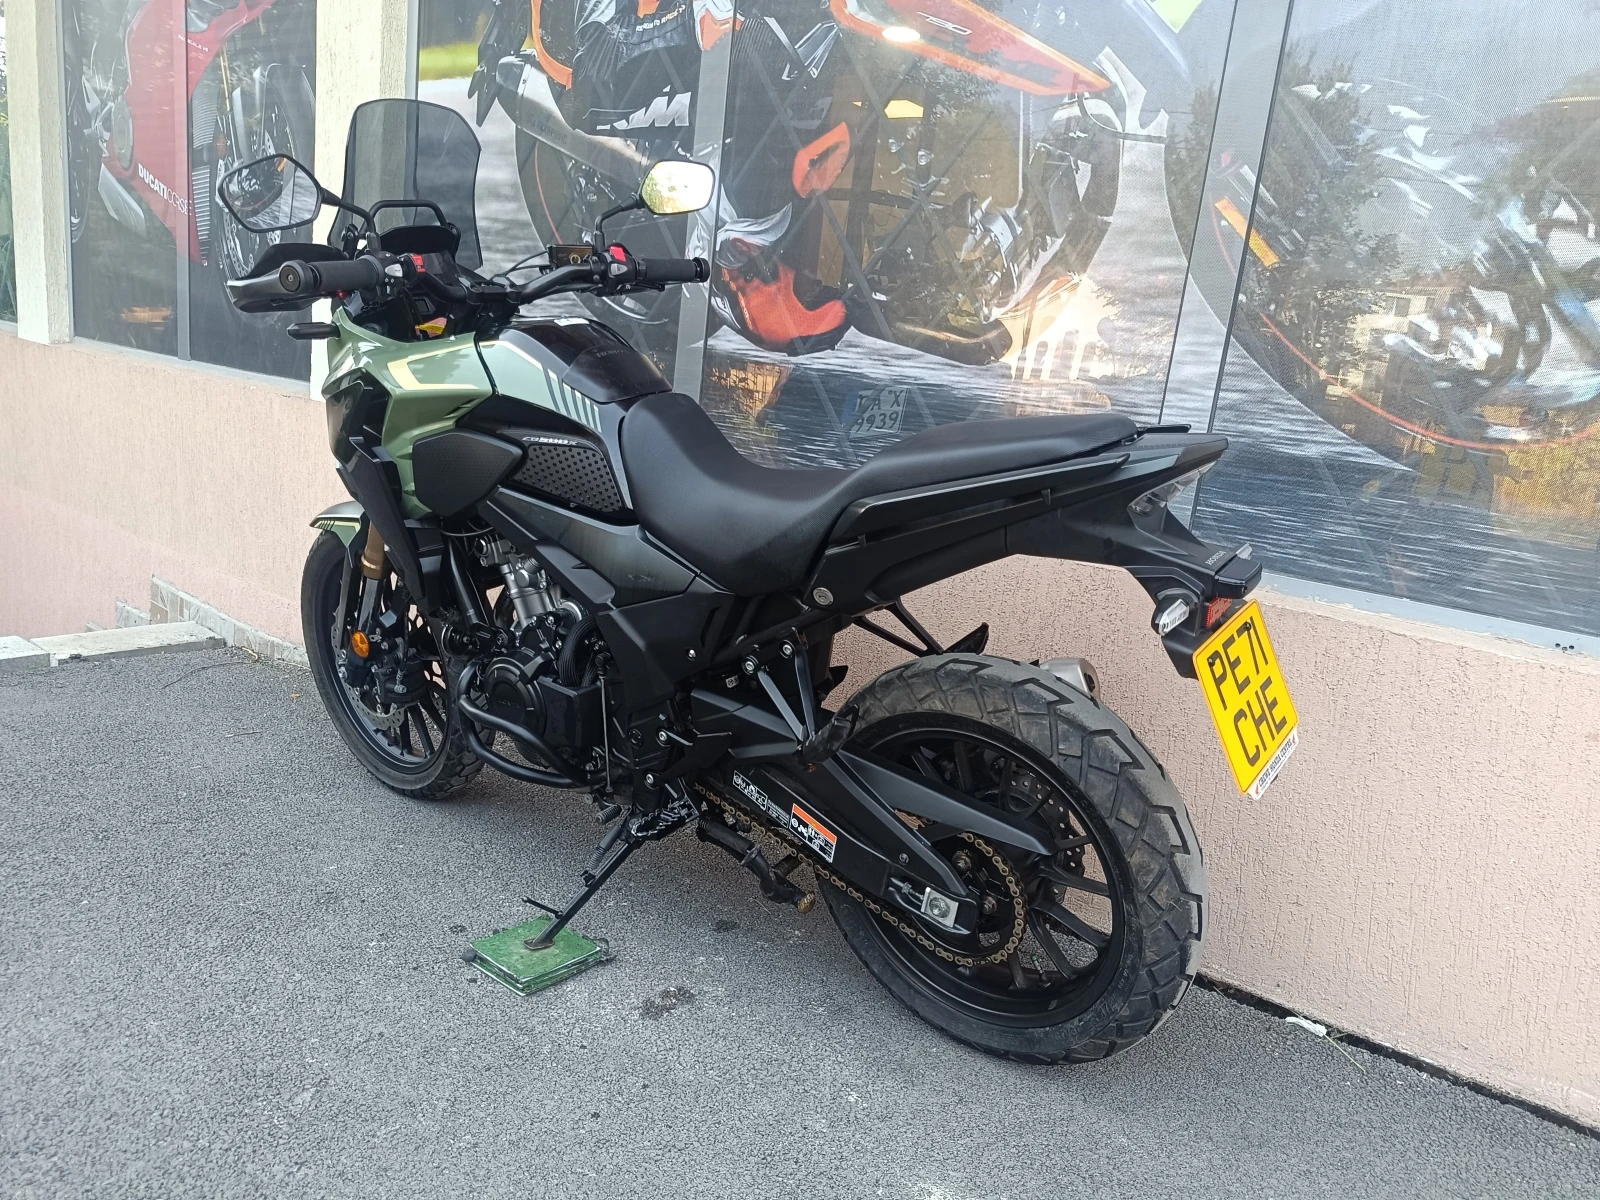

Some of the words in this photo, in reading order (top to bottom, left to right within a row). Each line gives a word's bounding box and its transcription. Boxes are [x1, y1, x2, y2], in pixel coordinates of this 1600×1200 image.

[661, 9, 679, 24] RACE
[138, 163, 168, 200] DUCATI
[1205, 550, 1227, 566] HONDA
[1206, 615, 1269, 712] PE71
[1233, 675, 1288, 768] CHE
